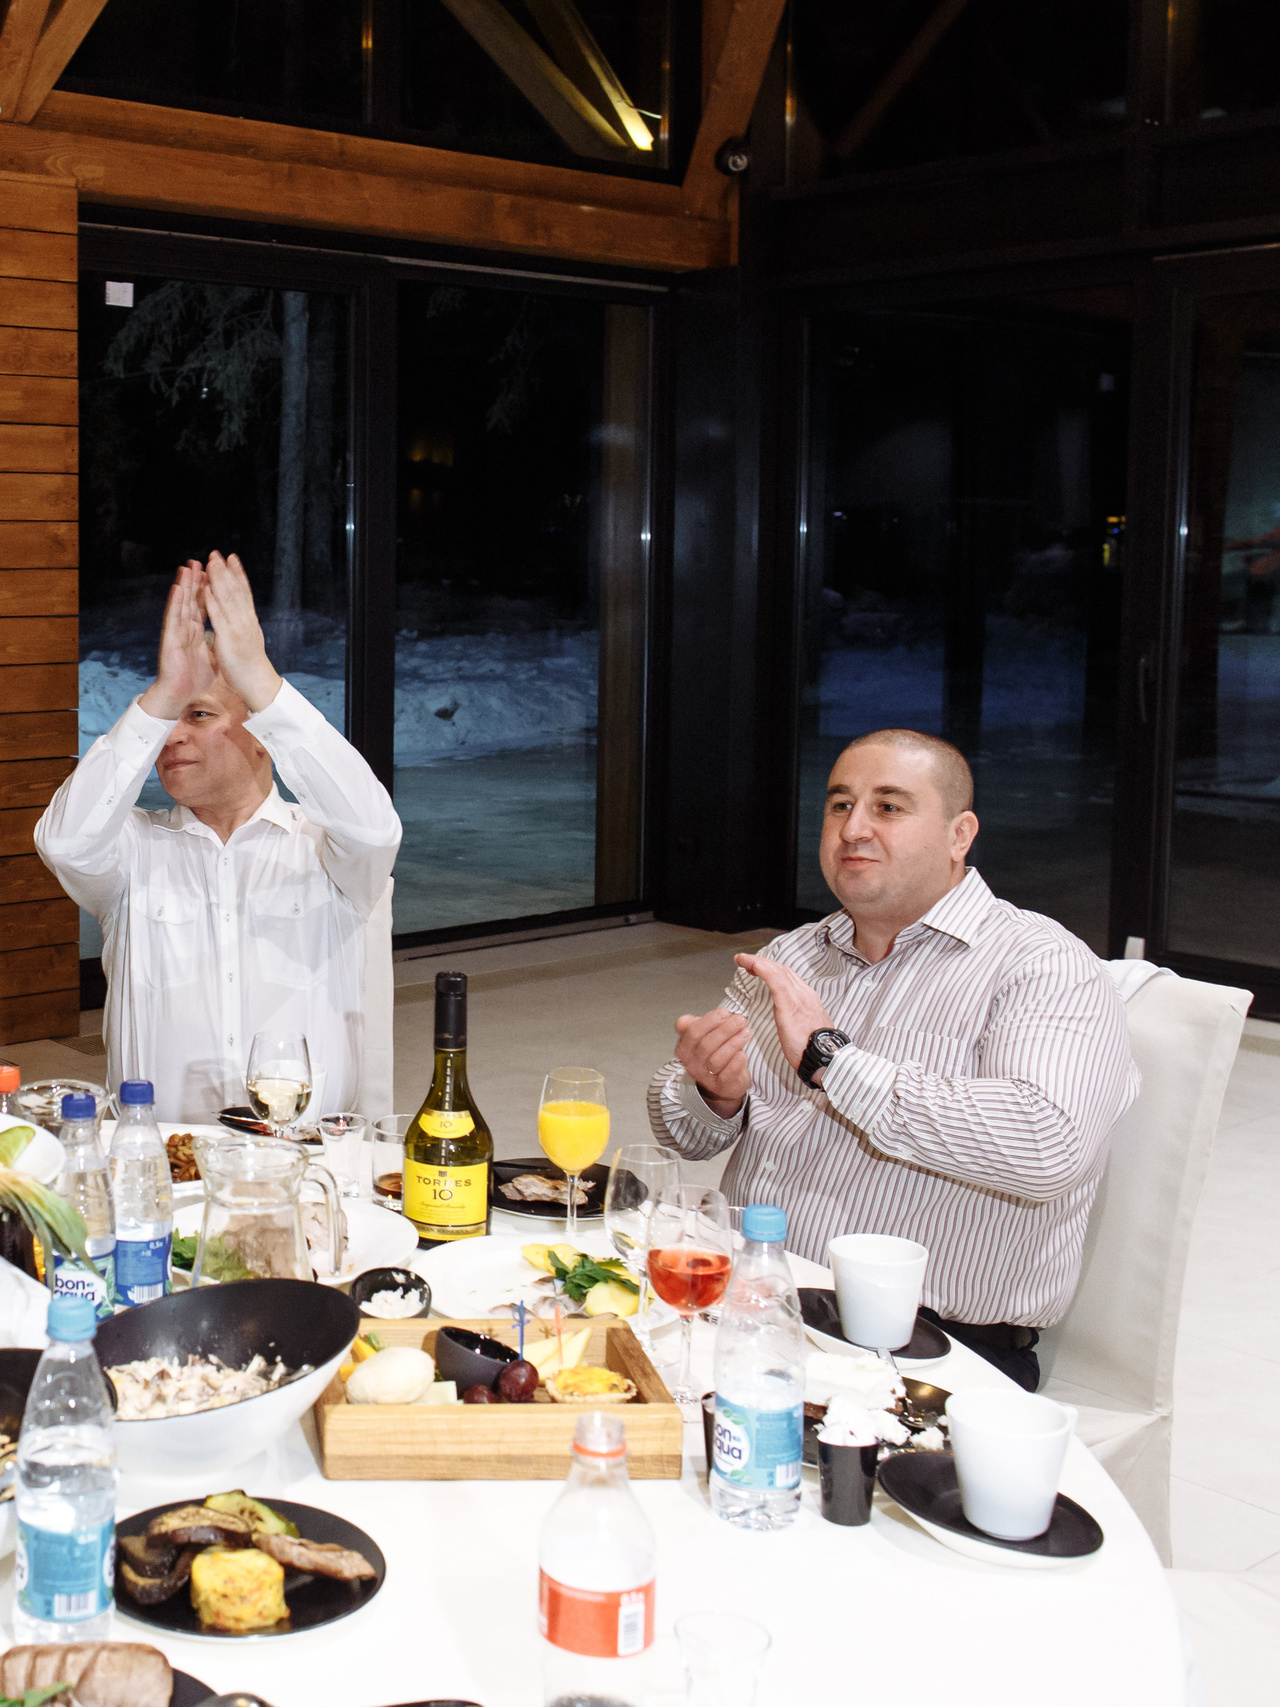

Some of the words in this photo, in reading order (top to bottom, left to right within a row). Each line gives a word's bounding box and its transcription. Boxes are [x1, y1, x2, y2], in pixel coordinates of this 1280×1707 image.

[440, 1121, 452, 1129] 10
[416, 1175, 472, 1188] TORRES
[433, 1189, 454, 1201] 10
[55, 1274, 86, 1291] bon
[715, 1423, 732, 1442] on
[714, 1437, 742, 1460] qua
